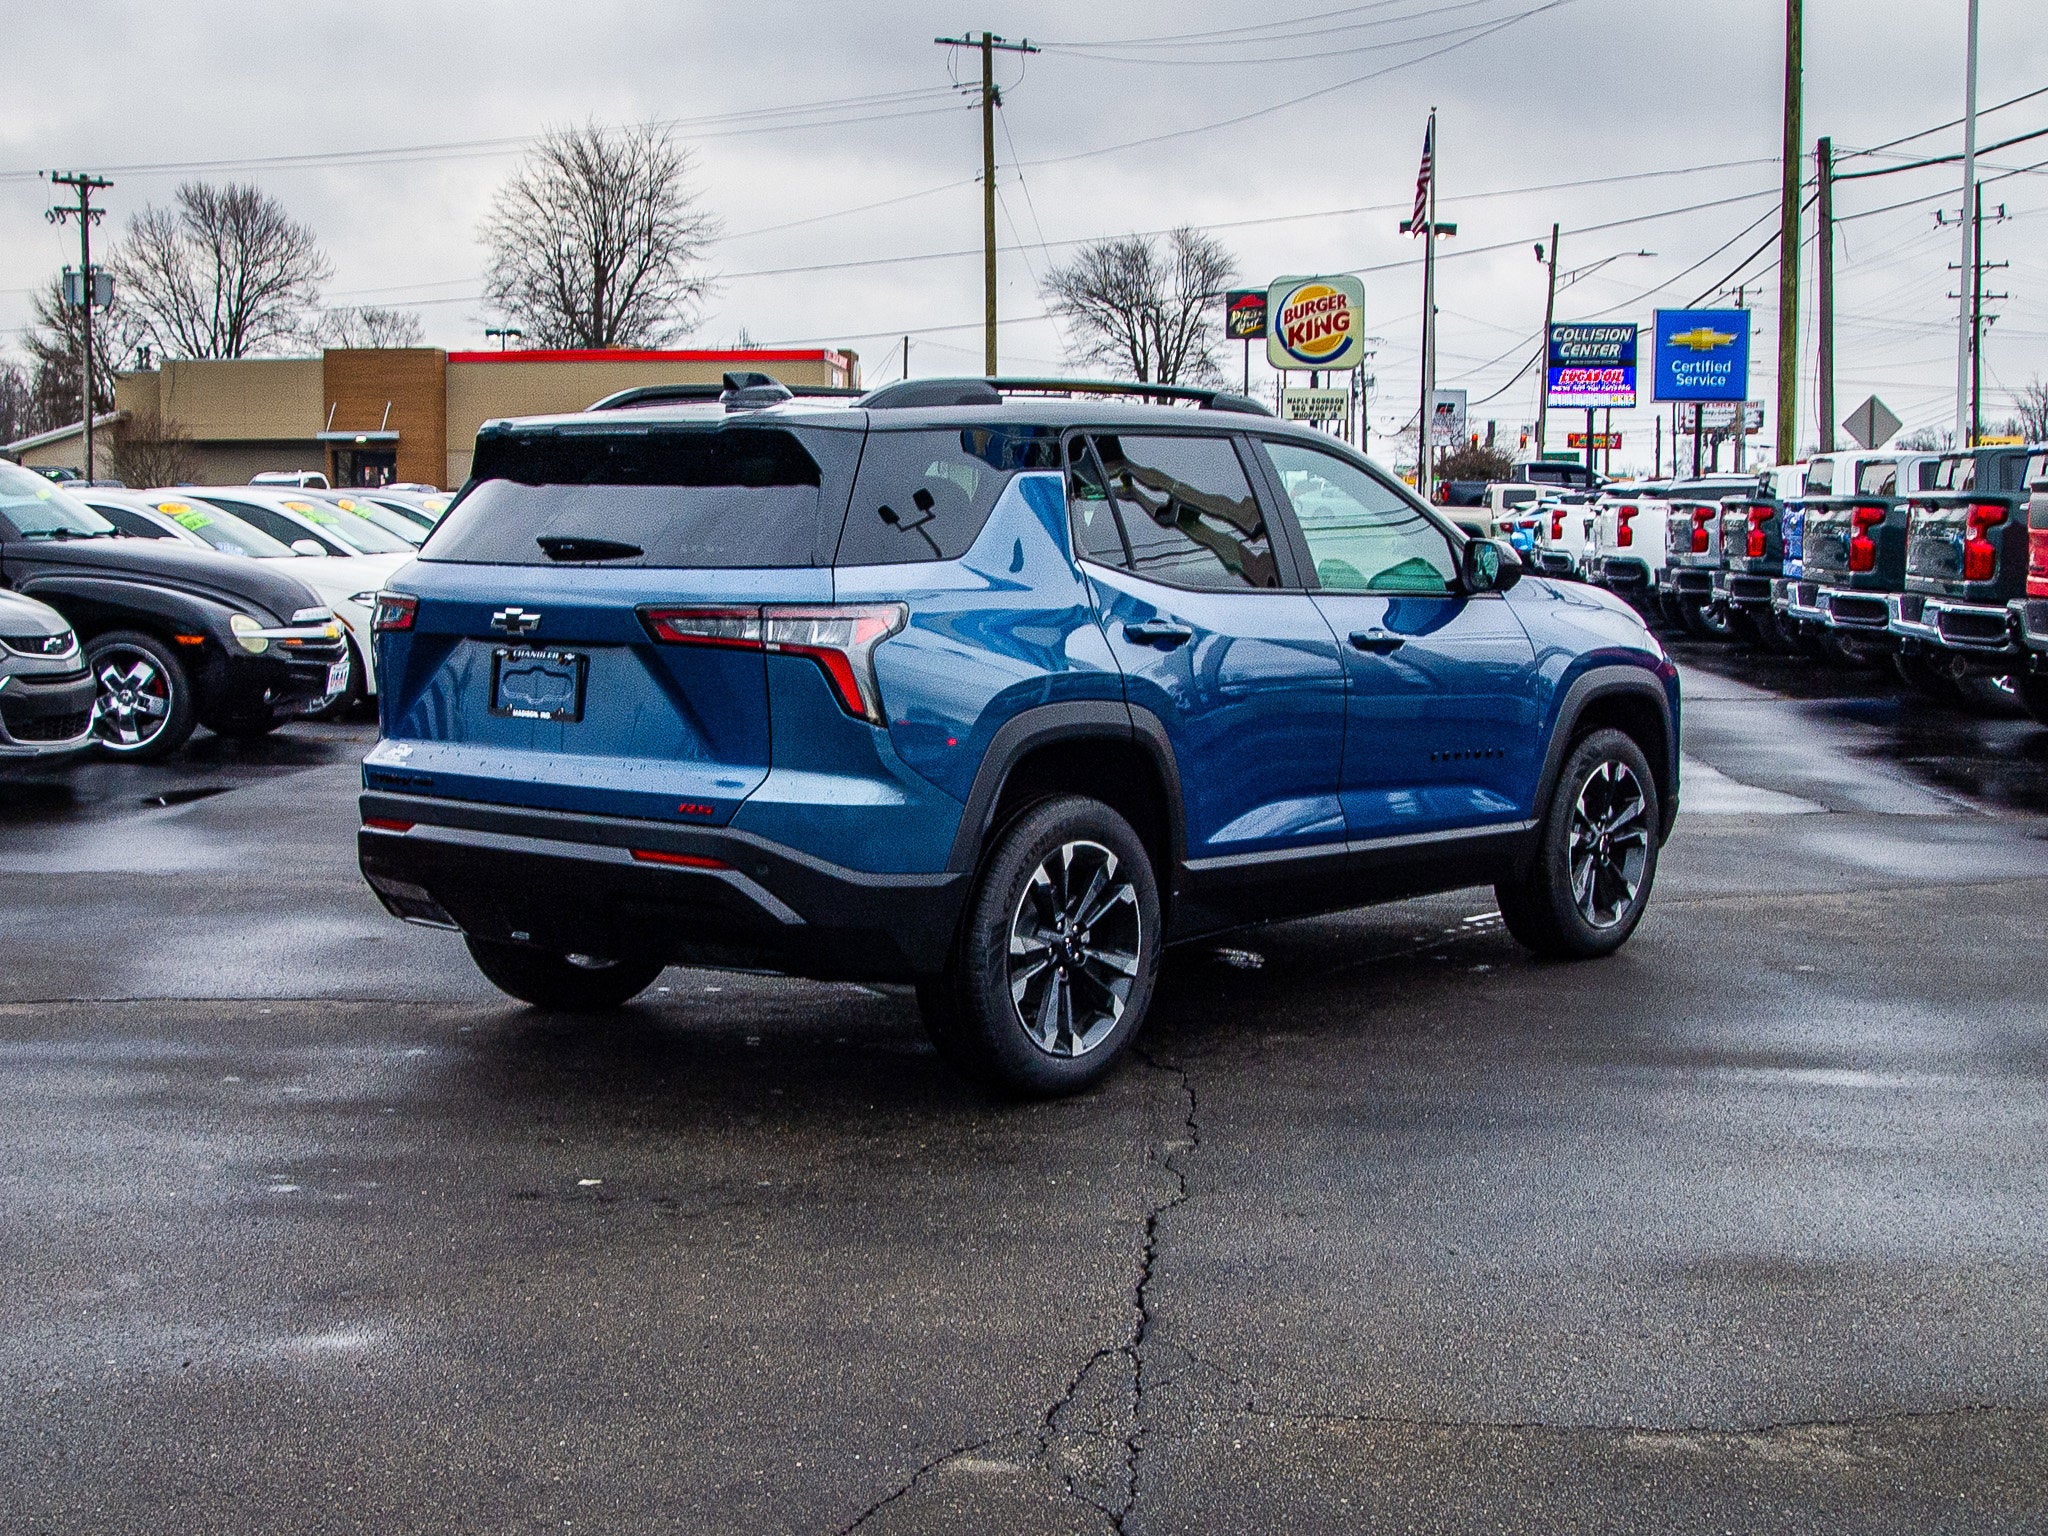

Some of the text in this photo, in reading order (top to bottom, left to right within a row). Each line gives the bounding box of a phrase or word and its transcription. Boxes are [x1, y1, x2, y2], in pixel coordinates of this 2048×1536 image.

[1283, 293, 1347, 325] BURGER
[1287, 310, 1350, 348] KING
[1552, 327, 1633, 342] COLLISION
[1559, 342, 1622, 358] CENTER
[1671, 360, 1731, 373] Certified
[1559, 369, 1624, 383] LUCAS OIL
[1675, 373, 1726, 387] Service
[513, 649, 559, 659] CHANDLER
